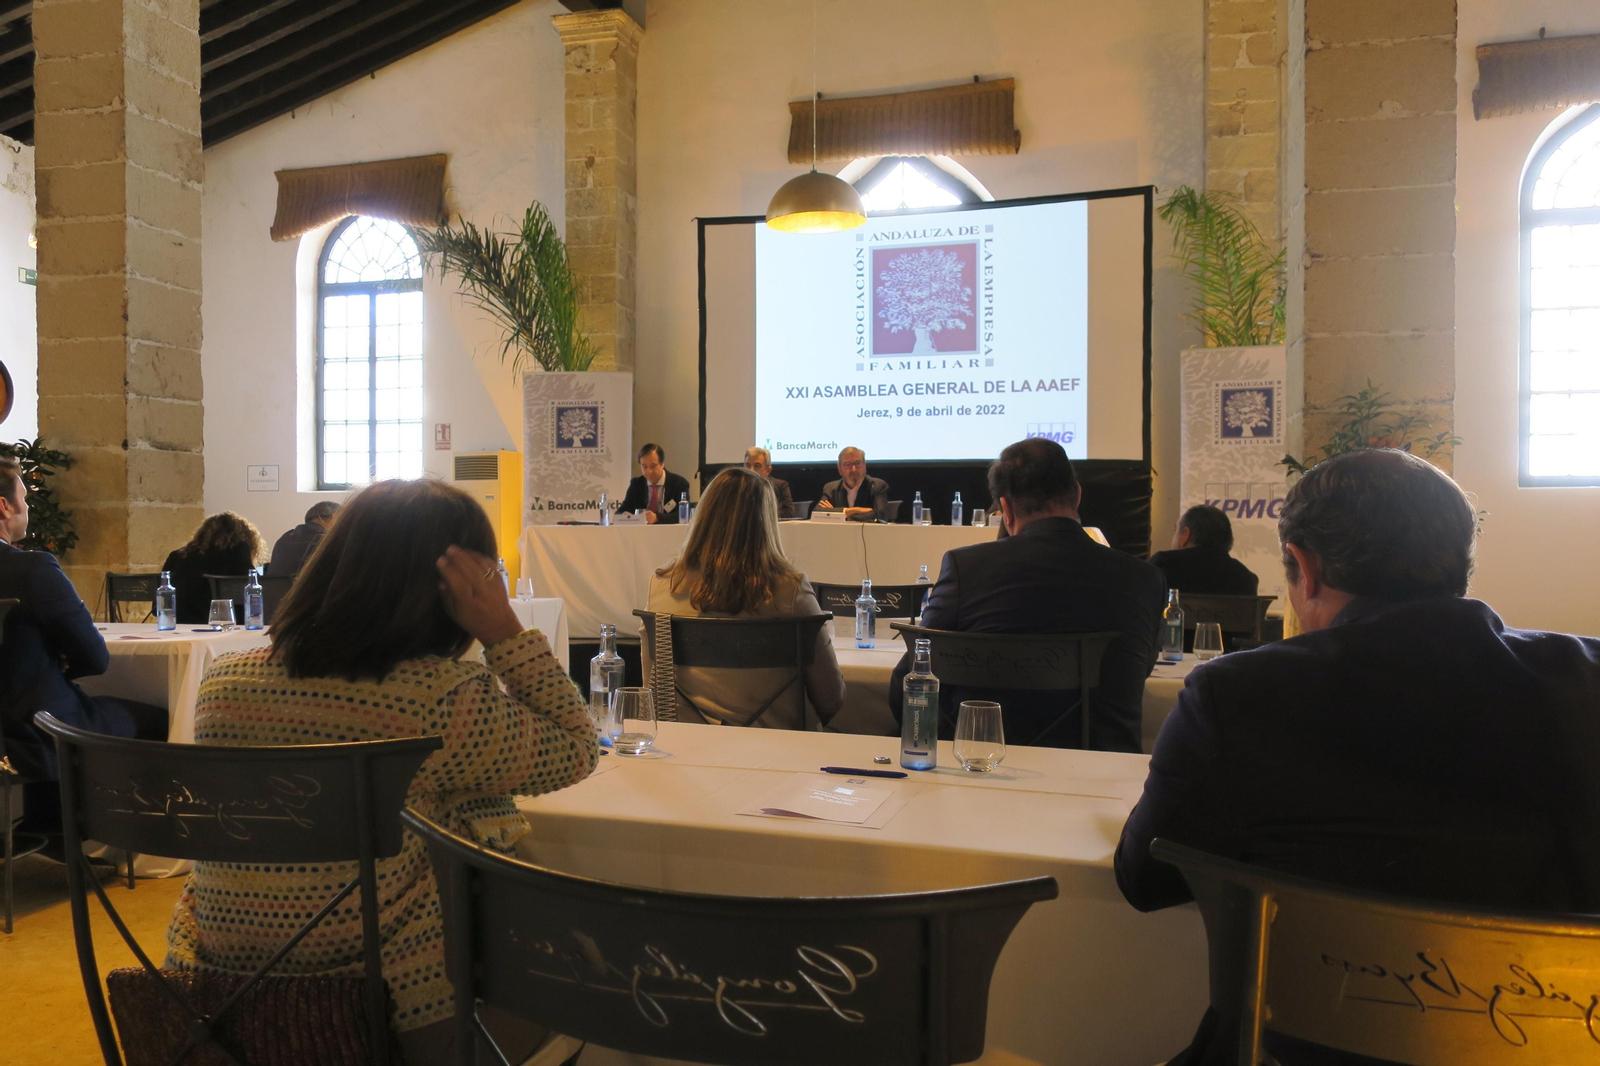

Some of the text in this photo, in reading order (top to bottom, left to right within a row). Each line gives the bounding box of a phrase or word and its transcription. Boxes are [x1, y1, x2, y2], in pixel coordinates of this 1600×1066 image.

[869, 225, 980, 242] ANDALUZA DE
[854, 246, 865, 359] ASOCIACIÓN
[983, 237, 994, 357] LA EMPRESA
[869, 358, 980, 372] FAMILIAR
[786, 378, 1081, 399] XXI ASAMBLEA GENERAL DE LA AAEF
[857, 404, 1006, 419] Jerez, 9 de abril de 2022
[776, 441, 838, 450] BancaMarch
[548, 499, 624, 510] BancaMch
